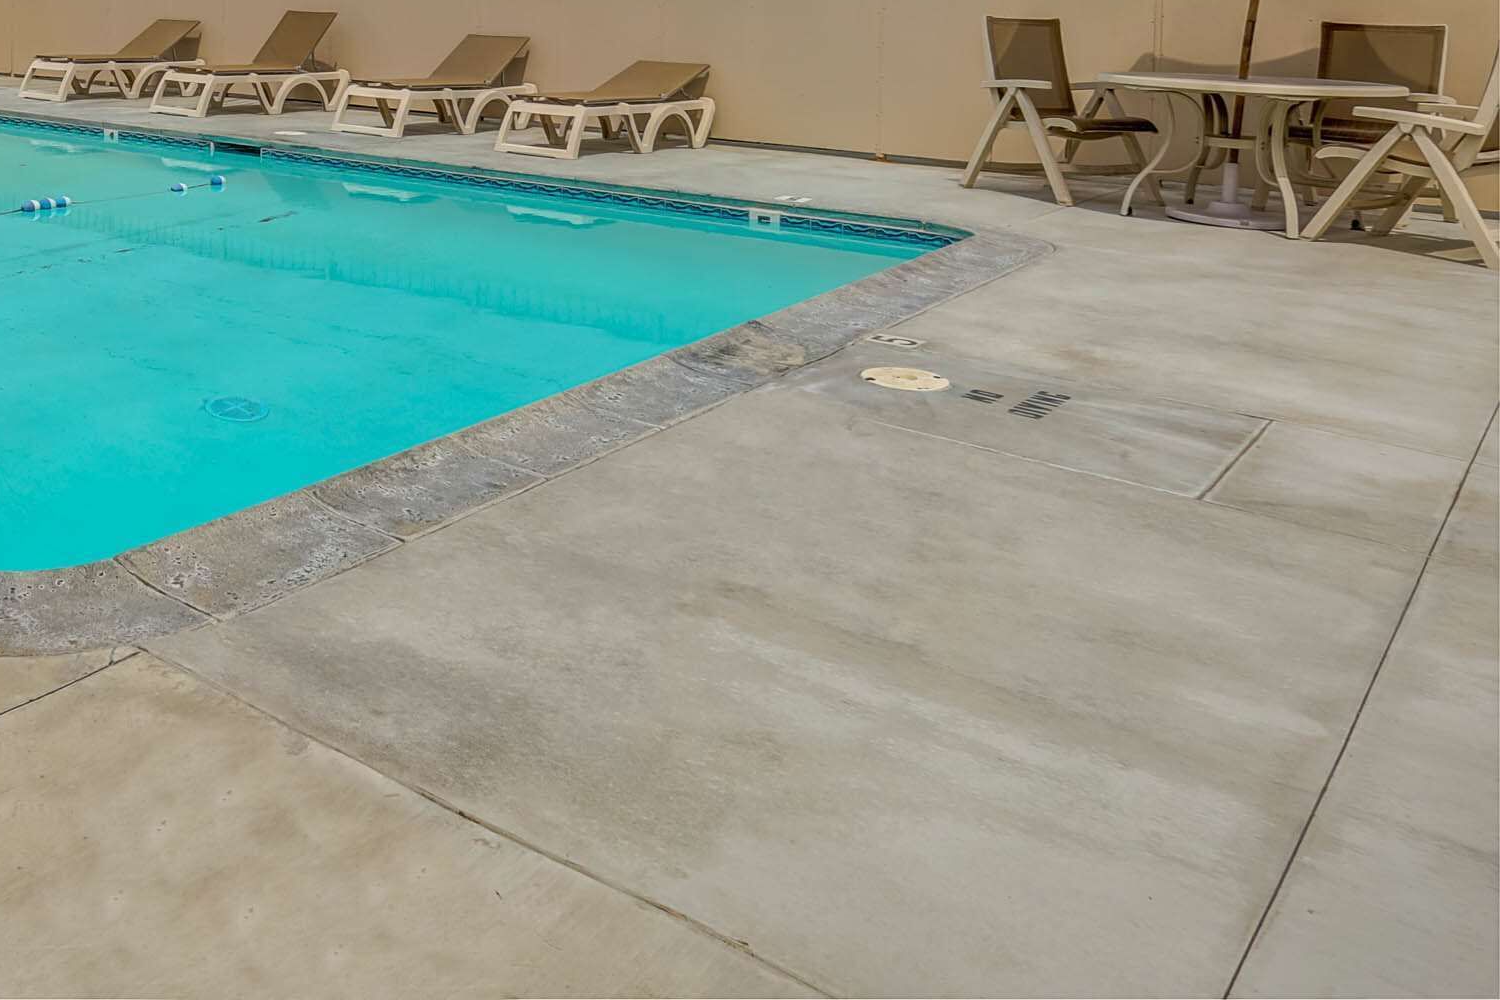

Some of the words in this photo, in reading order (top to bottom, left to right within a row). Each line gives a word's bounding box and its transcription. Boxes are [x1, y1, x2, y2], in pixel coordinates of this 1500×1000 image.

[871, 335, 918, 346] 5
[961, 389, 1005, 405] NO
[1007, 391, 1072, 420] DIVING
